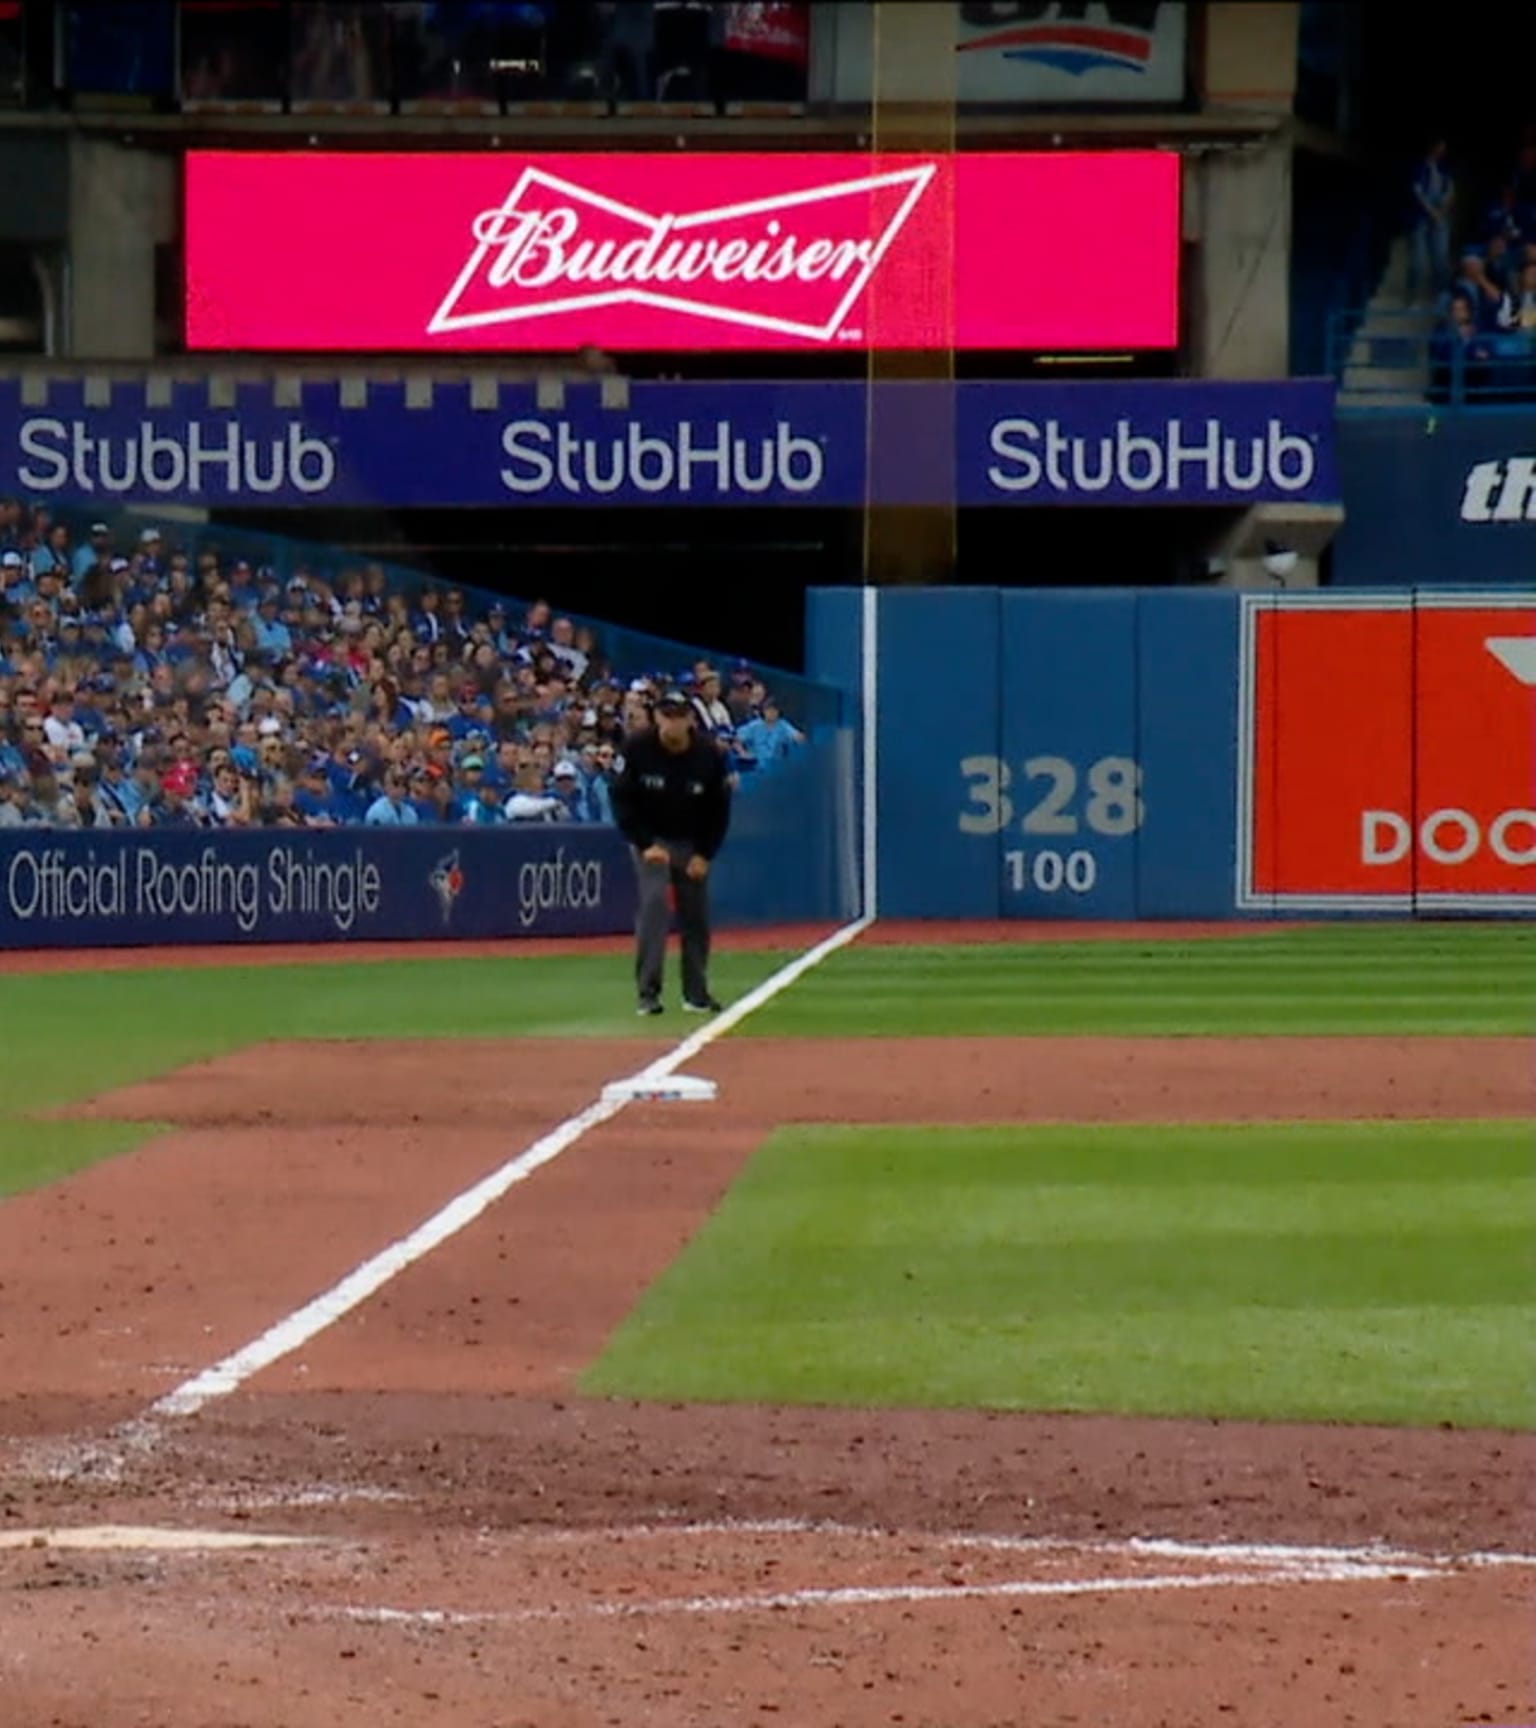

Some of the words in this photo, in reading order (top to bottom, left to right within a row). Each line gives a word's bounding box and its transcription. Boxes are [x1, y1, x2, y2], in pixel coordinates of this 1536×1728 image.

[472, 207, 873, 287] Budweiser
[16, 418, 336, 491] StubHub
[500, 420, 823, 493] StubHub
[987, 418, 1315, 491] StubHub
[959, 755, 1145, 836] 328
[8, 848, 127, 919] Official
[136, 848, 259, 931] Roofing
[268, 847, 381, 930] Shingle
[519, 851, 602, 926] gaf.ca
[1004, 850, 1097, 892] 100
